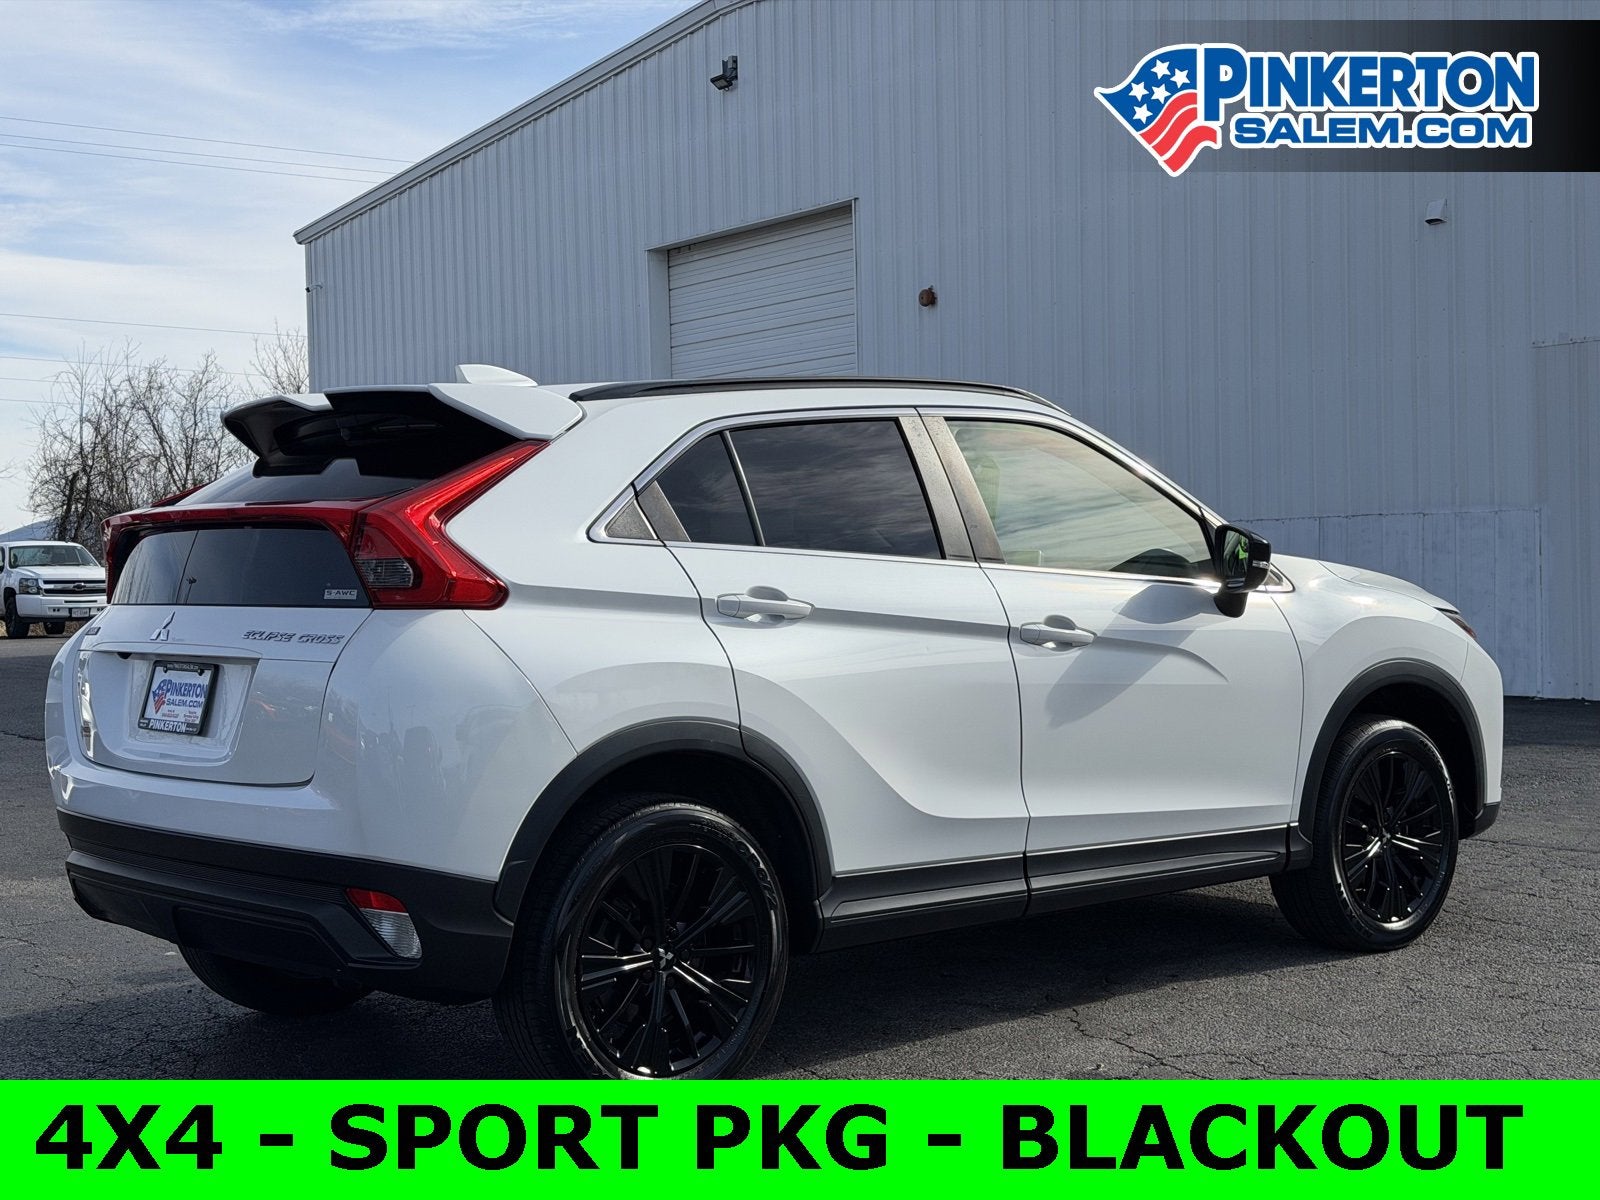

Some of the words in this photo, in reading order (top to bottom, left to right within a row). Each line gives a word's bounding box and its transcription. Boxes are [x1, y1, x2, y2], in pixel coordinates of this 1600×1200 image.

[243, 630, 297, 642] ECLIPSE
[298, 633, 346, 645] CROSS
[165, 679, 208, 699] PINKERTON
[166, 698, 203, 708] SALEM.COM
[148, 719, 187, 733] PINKERTON
